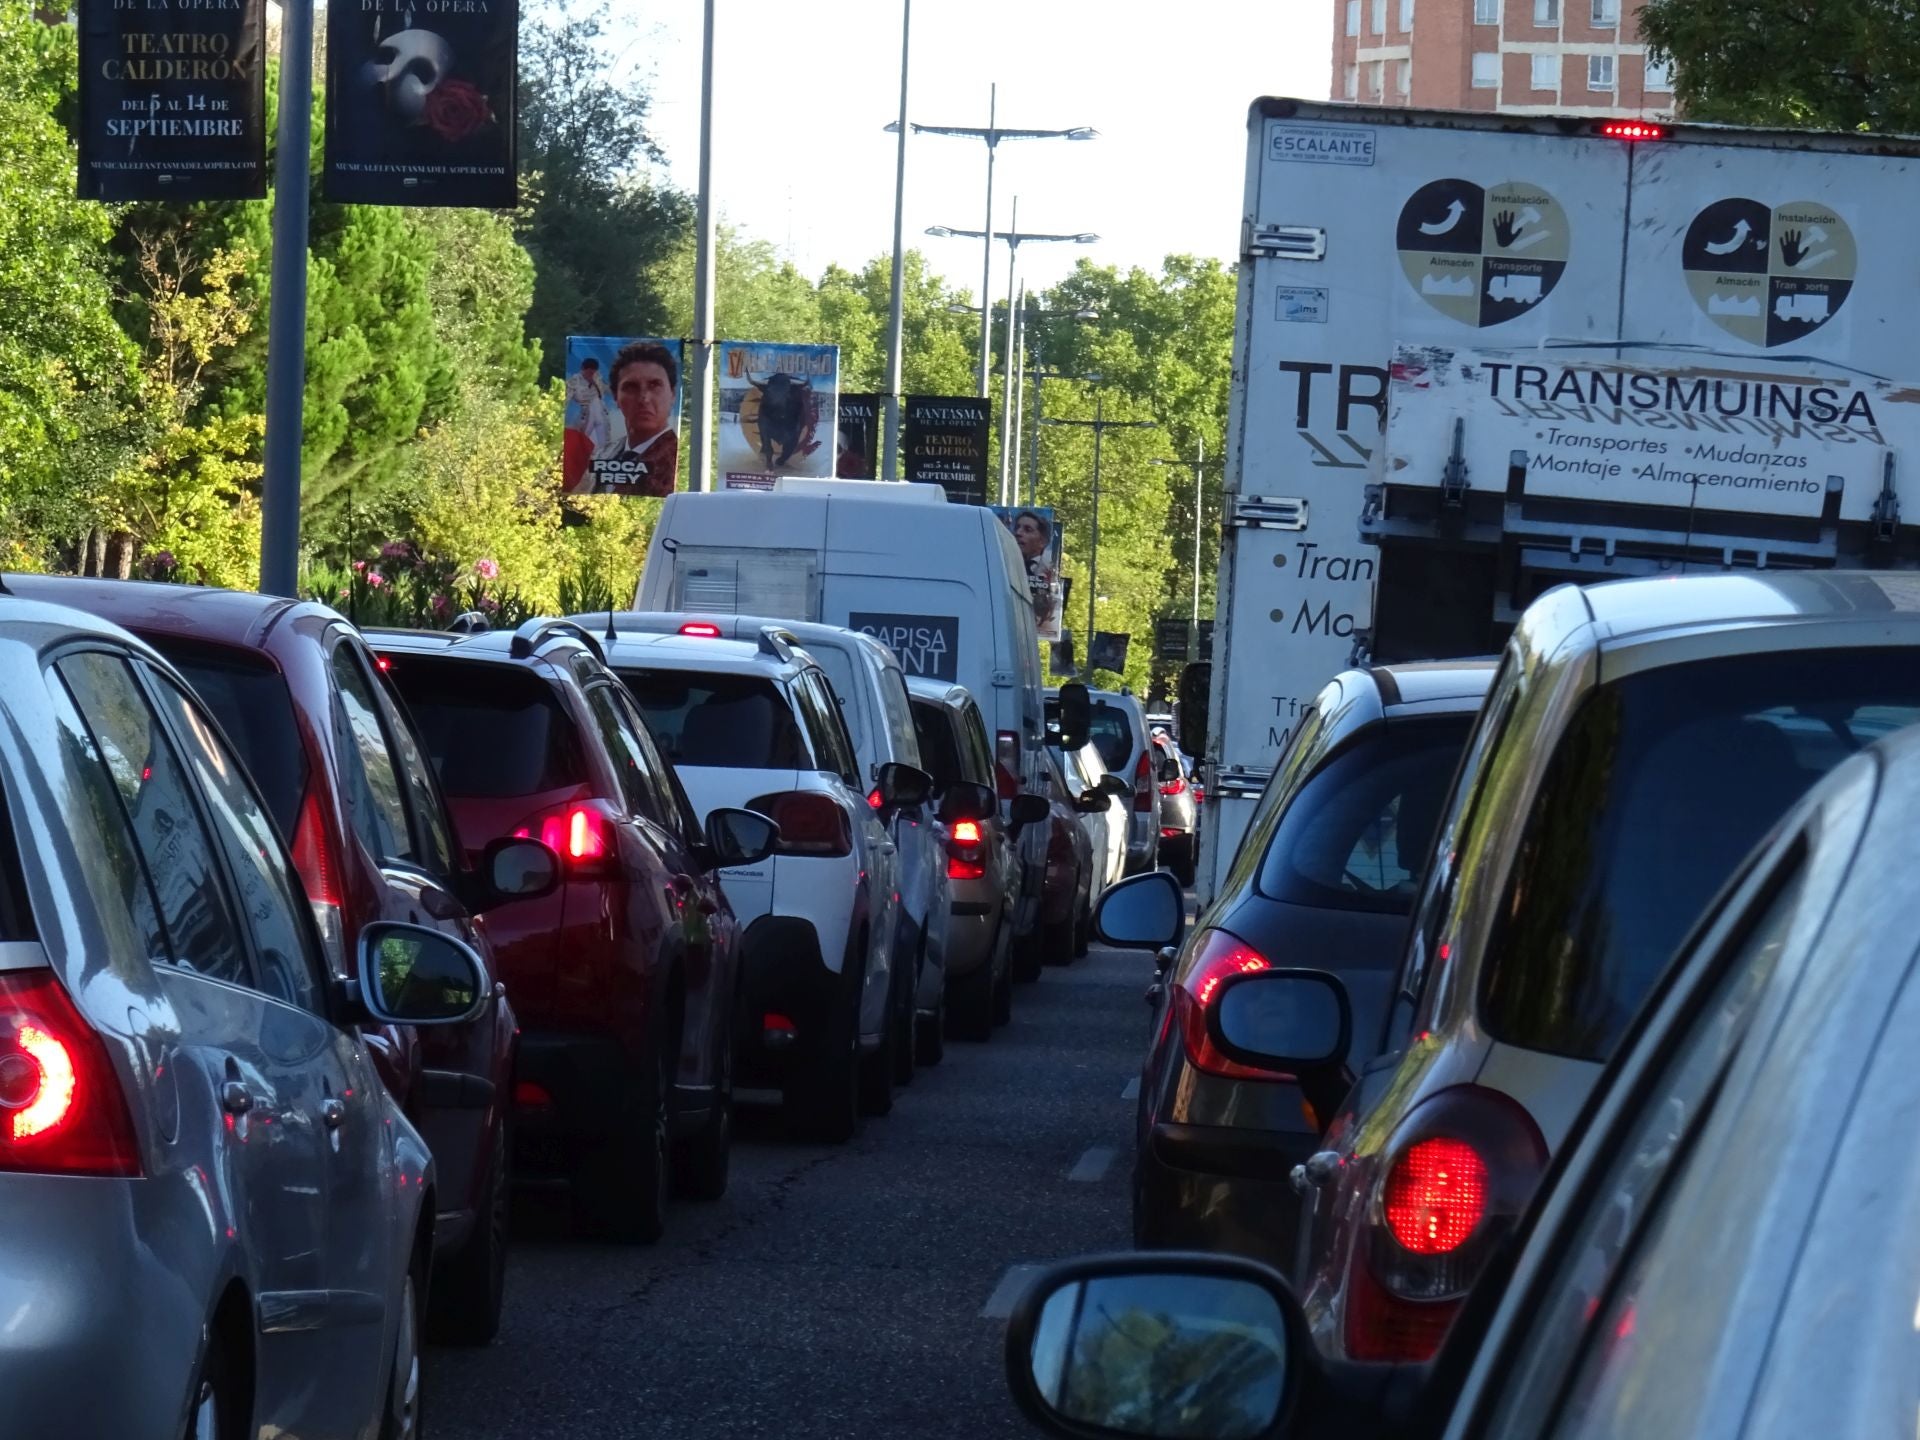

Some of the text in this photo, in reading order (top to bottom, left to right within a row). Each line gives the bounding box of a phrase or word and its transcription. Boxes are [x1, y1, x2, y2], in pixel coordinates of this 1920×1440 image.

[113, 0, 136, 9] DE
[147, 0, 168, 9] LA
[361, 0, 384, 11] DE
[395, 0, 416, 12] LA
[122, 33, 229, 54] TEATRO
[102, 54, 247, 80] CALDERÓN
[122, 94, 229, 111] DEL 5 AL 14 DE
[106, 119, 243, 136] SEPTIEMBRE
[1273, 137, 1372, 155] ESCALANTE
[1491, 194, 1549, 205] Instalación
[1778, 213, 1836, 225] Instalación
[1430, 256, 1474, 268] Almacén
[1488, 260, 1543, 273] Transporte
[1716, 276, 1760, 287] Almacén
[1279, 361, 1390, 431] TR
[1480, 362, 1877, 427] TRANSMUINSA
[916, 408, 984, 420] FANTASMA
[924, 435, 972, 446] TEATRO
[1548, 427, 1668, 454] Transportes
[1693, 444, 1807, 468] Mudanzas
[594, 461, 648, 474] ROCA
[1531, 454, 1621, 480] Montaje
[600, 473, 640, 484] REY
[916, 471, 976, 482] SEPTIEMBRE
[1638, 462, 1820, 494] Almacenamiento
[1296, 542, 1374, 581] Tran
[1291, 599, 1354, 638] Mo
